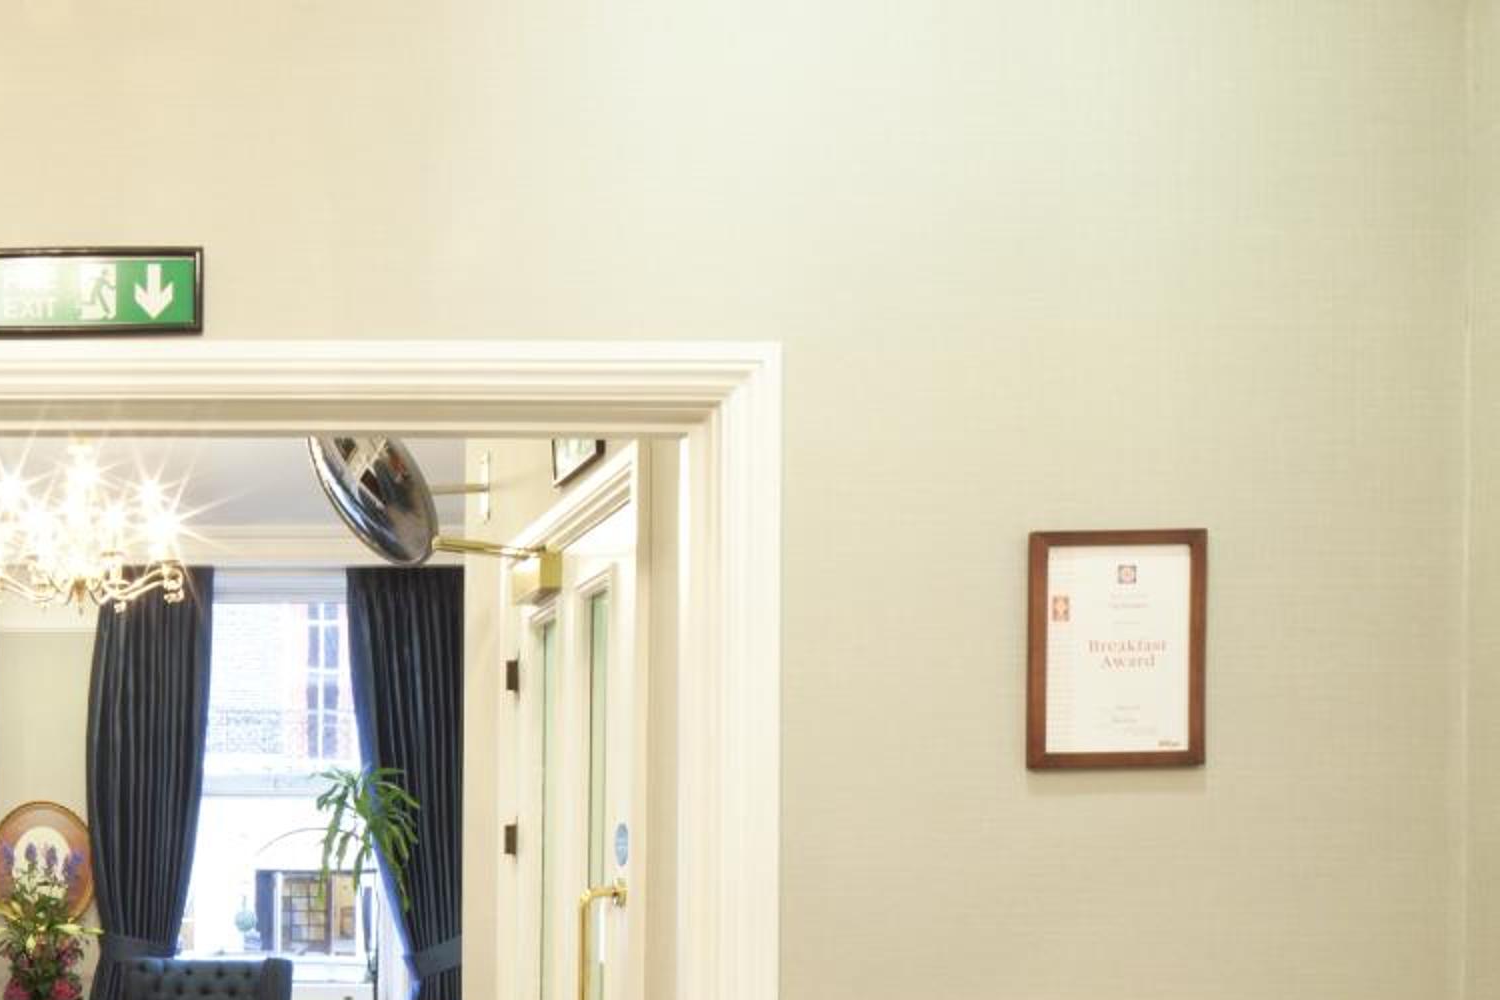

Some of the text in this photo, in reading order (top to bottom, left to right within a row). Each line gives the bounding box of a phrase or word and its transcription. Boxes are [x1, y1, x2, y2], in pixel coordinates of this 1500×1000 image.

[3, 297, 56, 319] EXIT
[1088, 639, 1167, 653] Breakfast
[1100, 654, 1156, 668] Award
